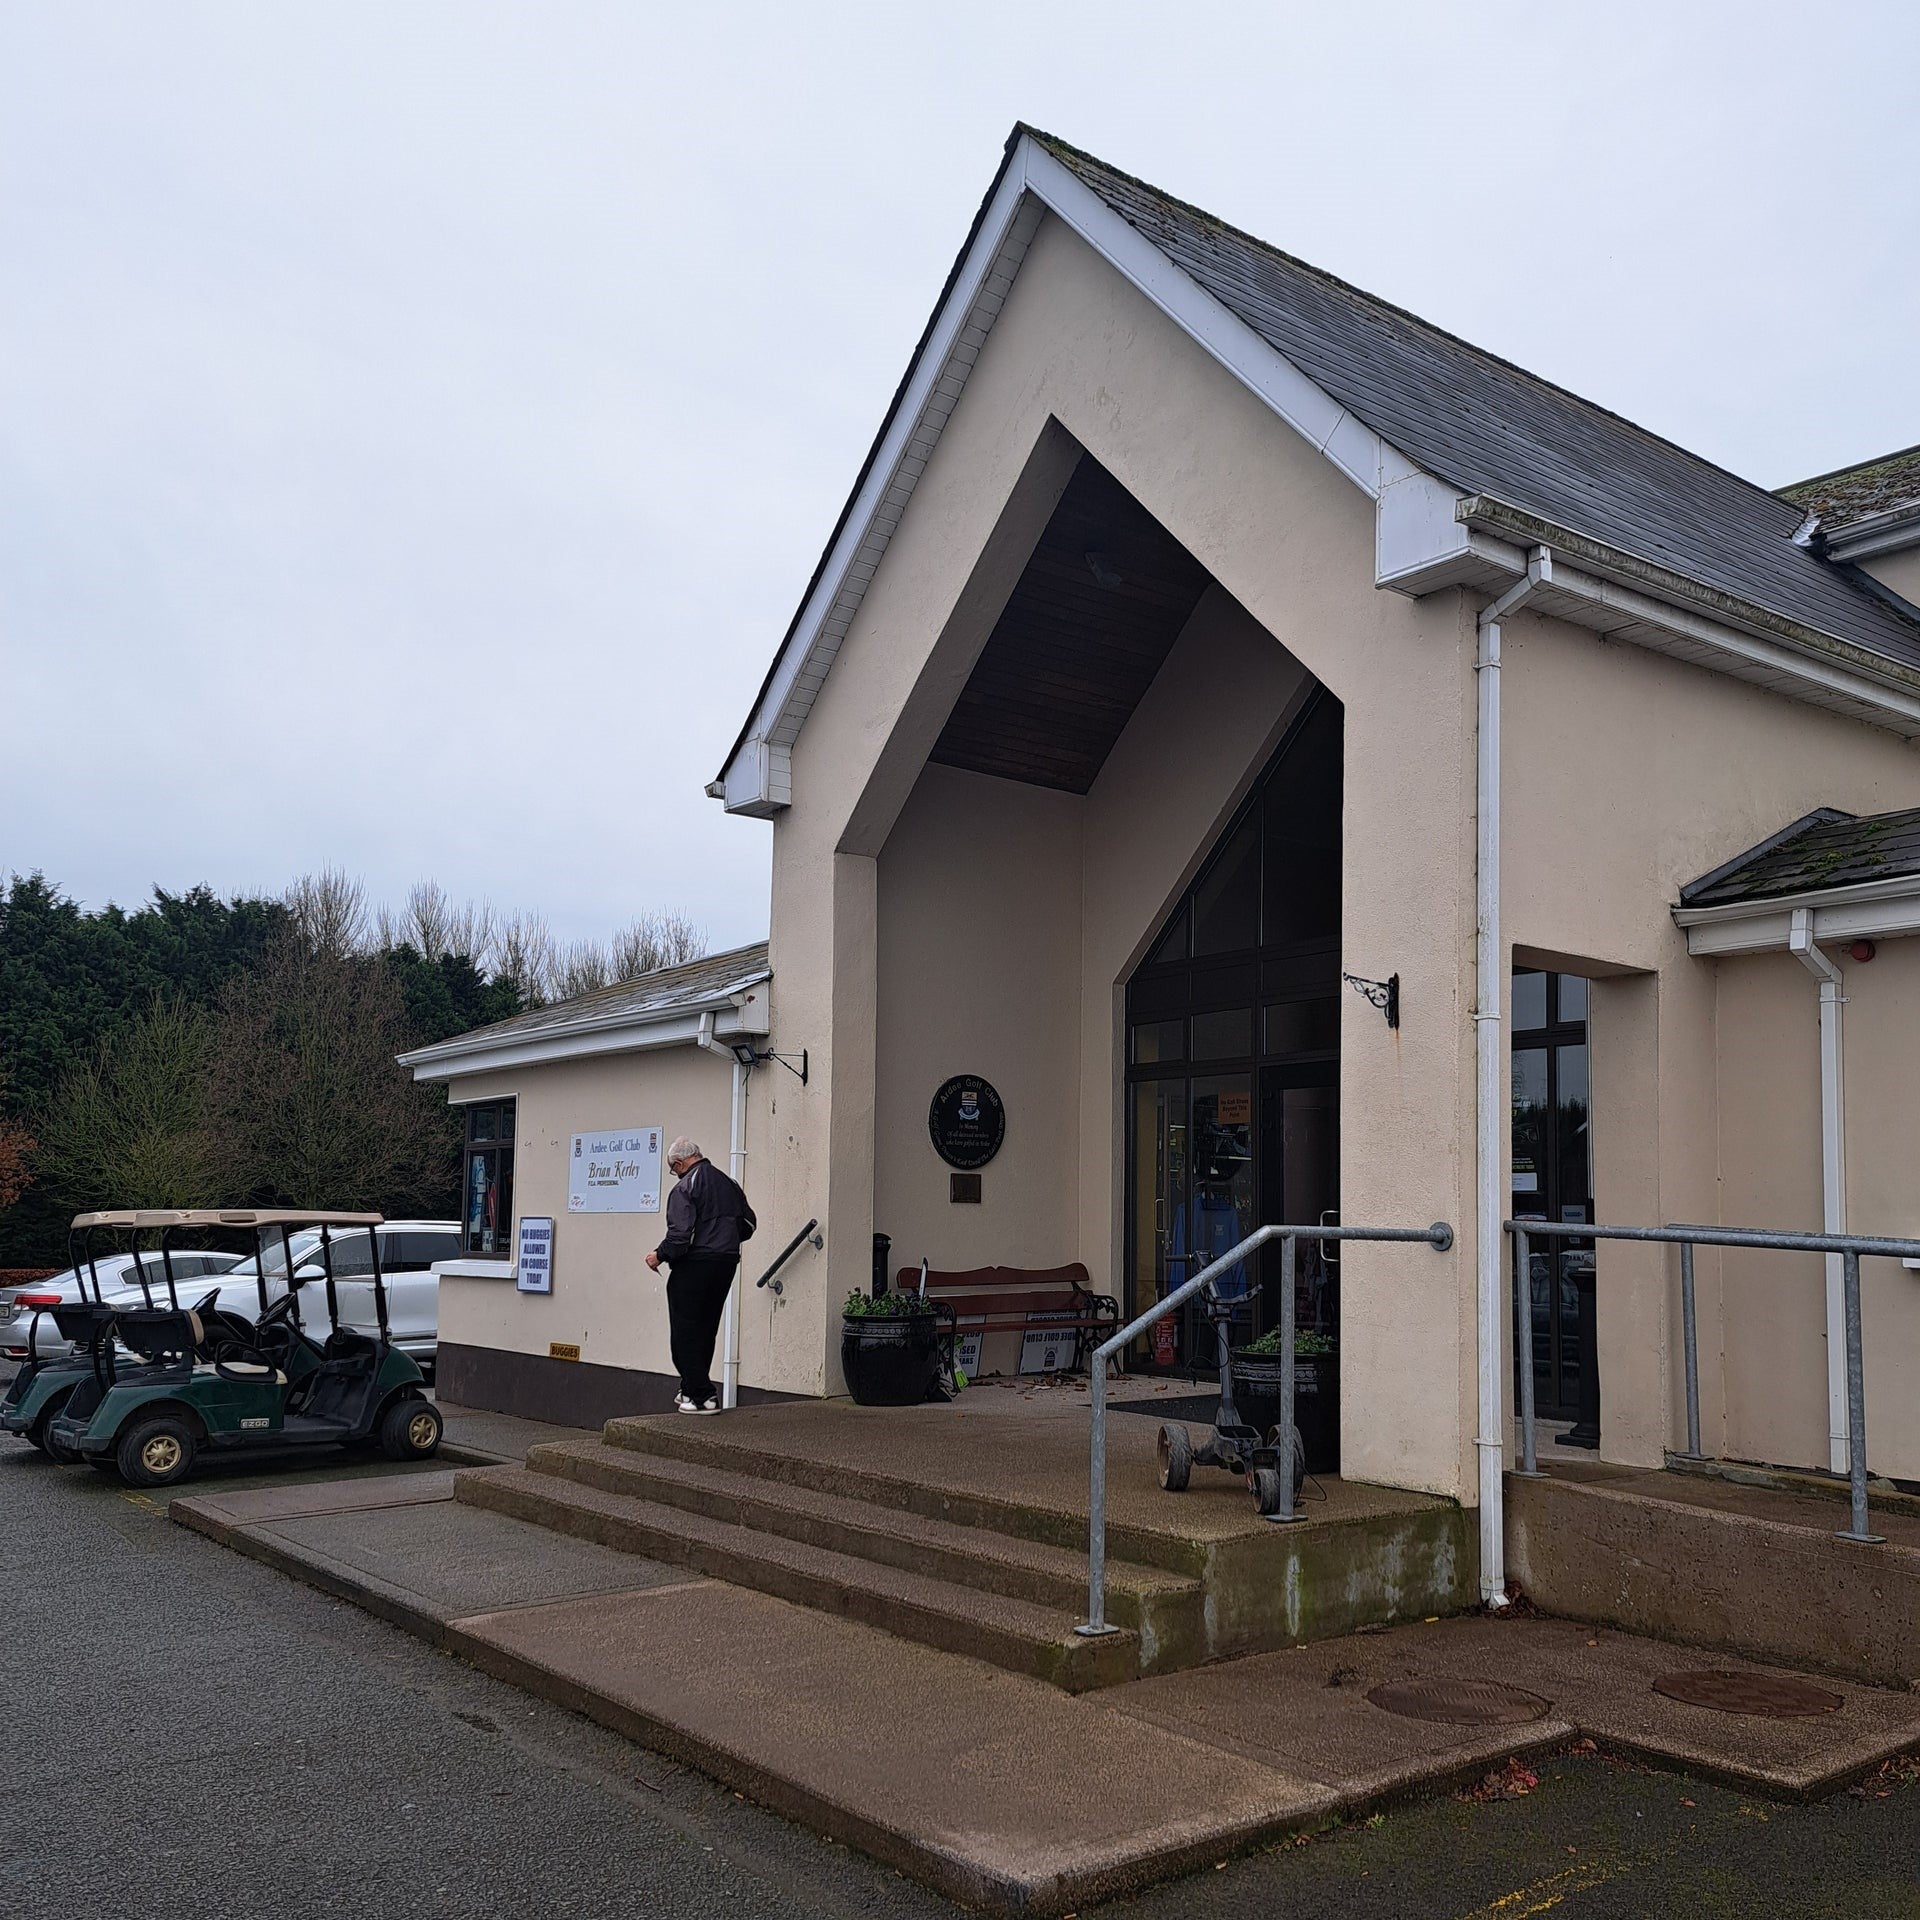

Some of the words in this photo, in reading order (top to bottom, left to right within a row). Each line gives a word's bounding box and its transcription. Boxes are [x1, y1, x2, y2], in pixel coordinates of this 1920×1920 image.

[940, 1082, 962, 1104] Ardee
[965, 1078, 983, 1090] Golf
[984, 1087, 998, 1107] Club
[589, 1142, 607, 1153] Ardee
[609, 1140, 623, 1152] Golf
[625, 1138, 640, 1151] Club
[588, 1162, 610, 1178] Brian
[614, 1160, 640, 1181] Kerley
[521, 1229, 528, 1239] NO
[529, 1229, 550, 1240] BUGGIES
[523, 1244, 546, 1255] ALLOWED
[521, 1258, 528, 1269] ON
[529, 1258, 548, 1270] COURSE
[526, 1273, 542, 1284] TODAY
[1026, 1333, 1043, 1343] CLUB
[1043, 1333, 1059, 1341] GOLF
[551, 1345, 578, 1358] BUGGIES
